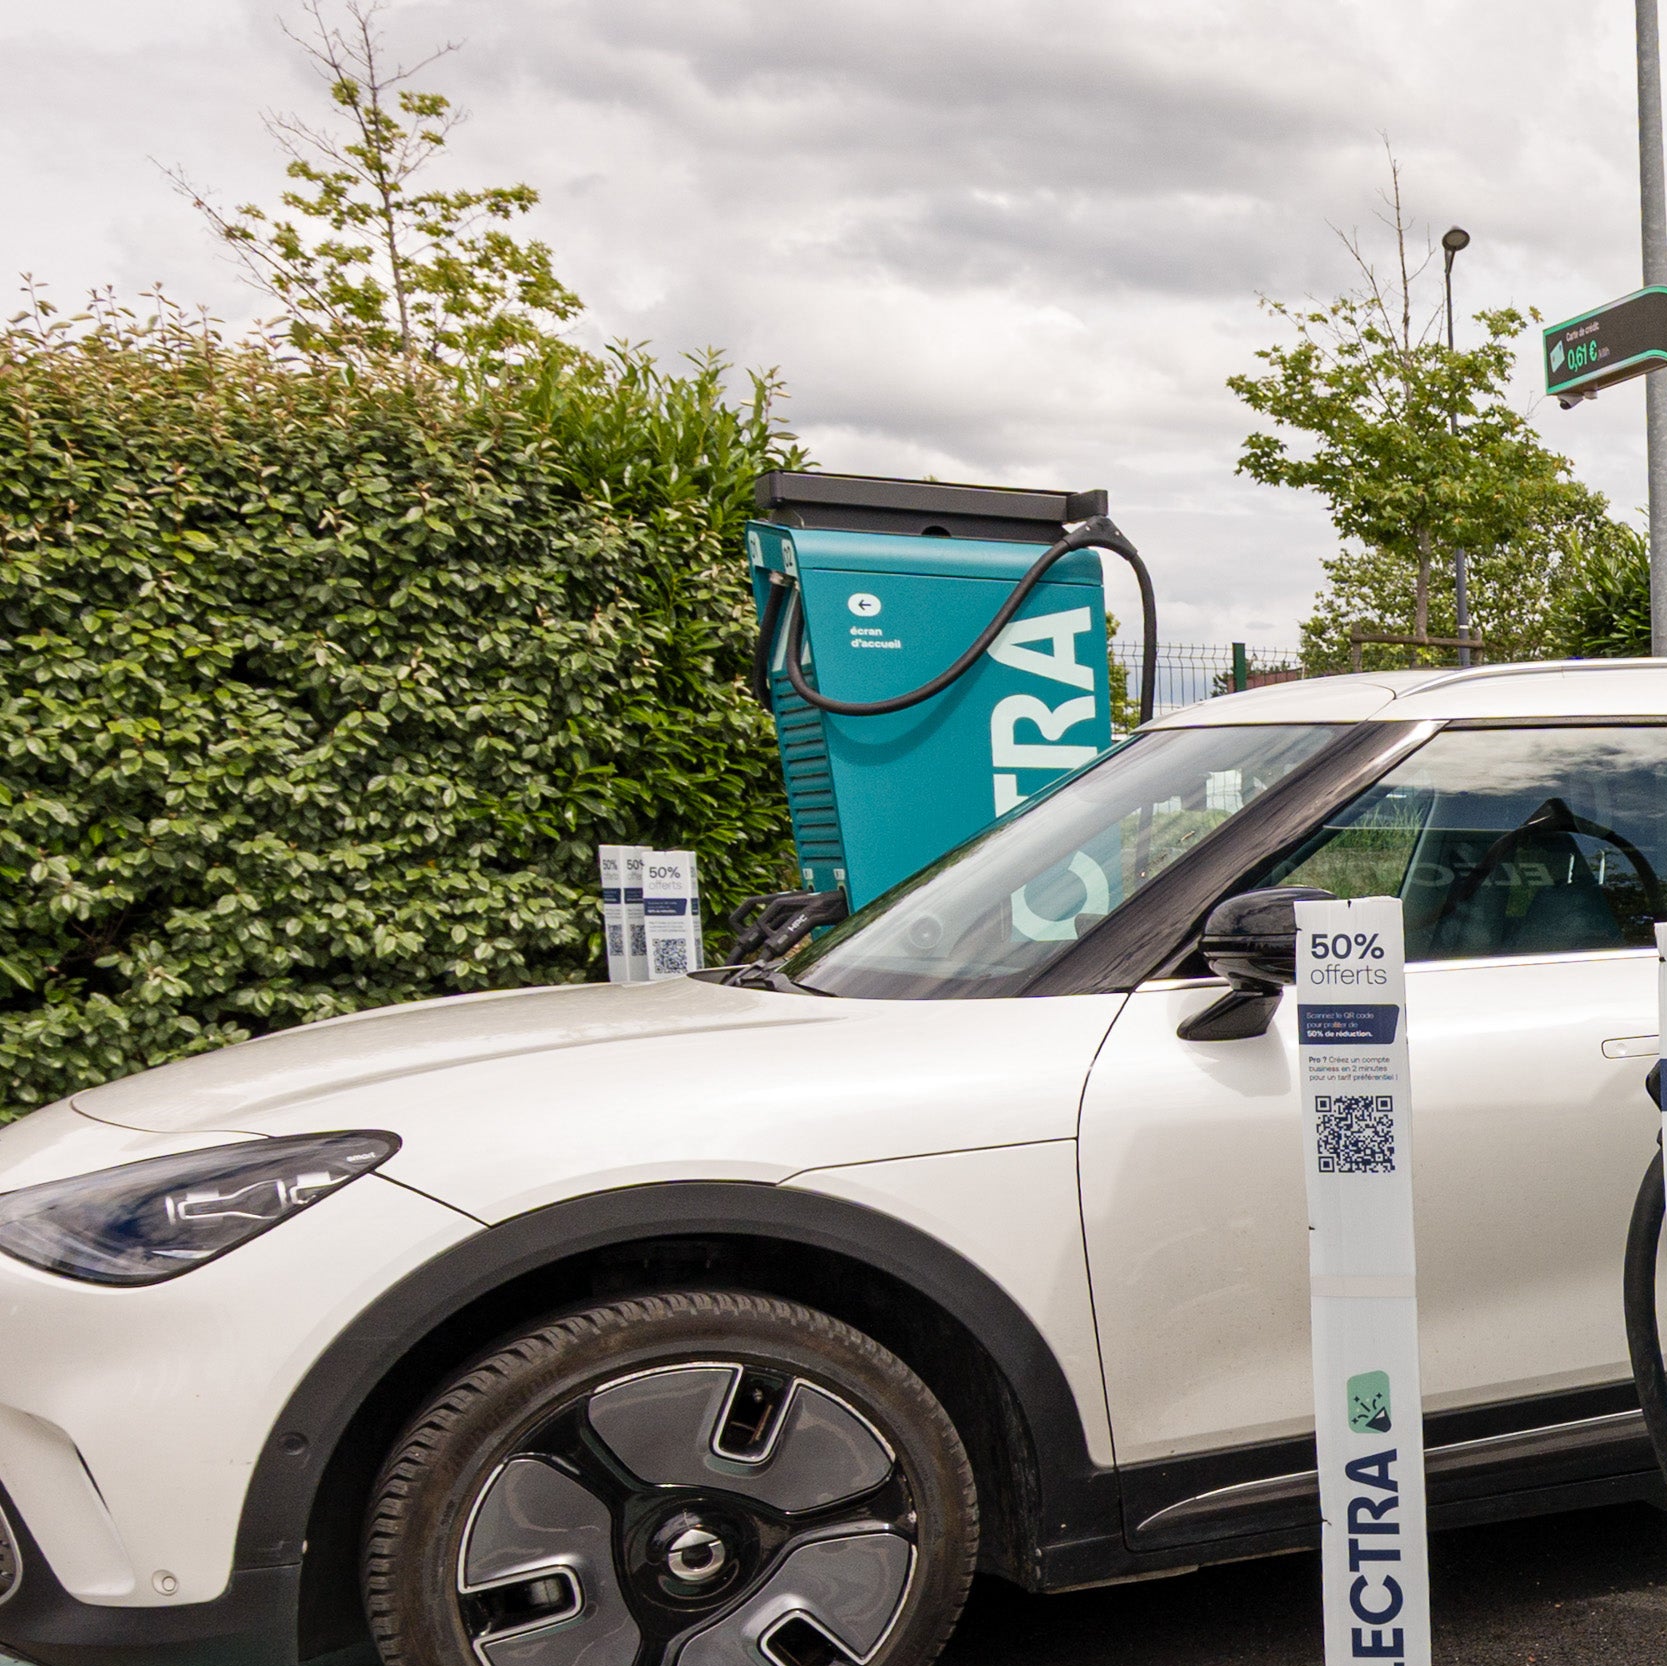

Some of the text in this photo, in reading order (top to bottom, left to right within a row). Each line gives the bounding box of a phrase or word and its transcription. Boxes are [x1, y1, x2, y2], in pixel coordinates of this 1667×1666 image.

[1567, 342, 1587, 372] 0,61
[850, 626, 883, 636] écran
[851, 638, 901, 649] d'accueil
[649, 866, 681, 879] 50%
[1311, 933, 1384, 960] 50%
[1310, 963, 1387, 985] offerts
